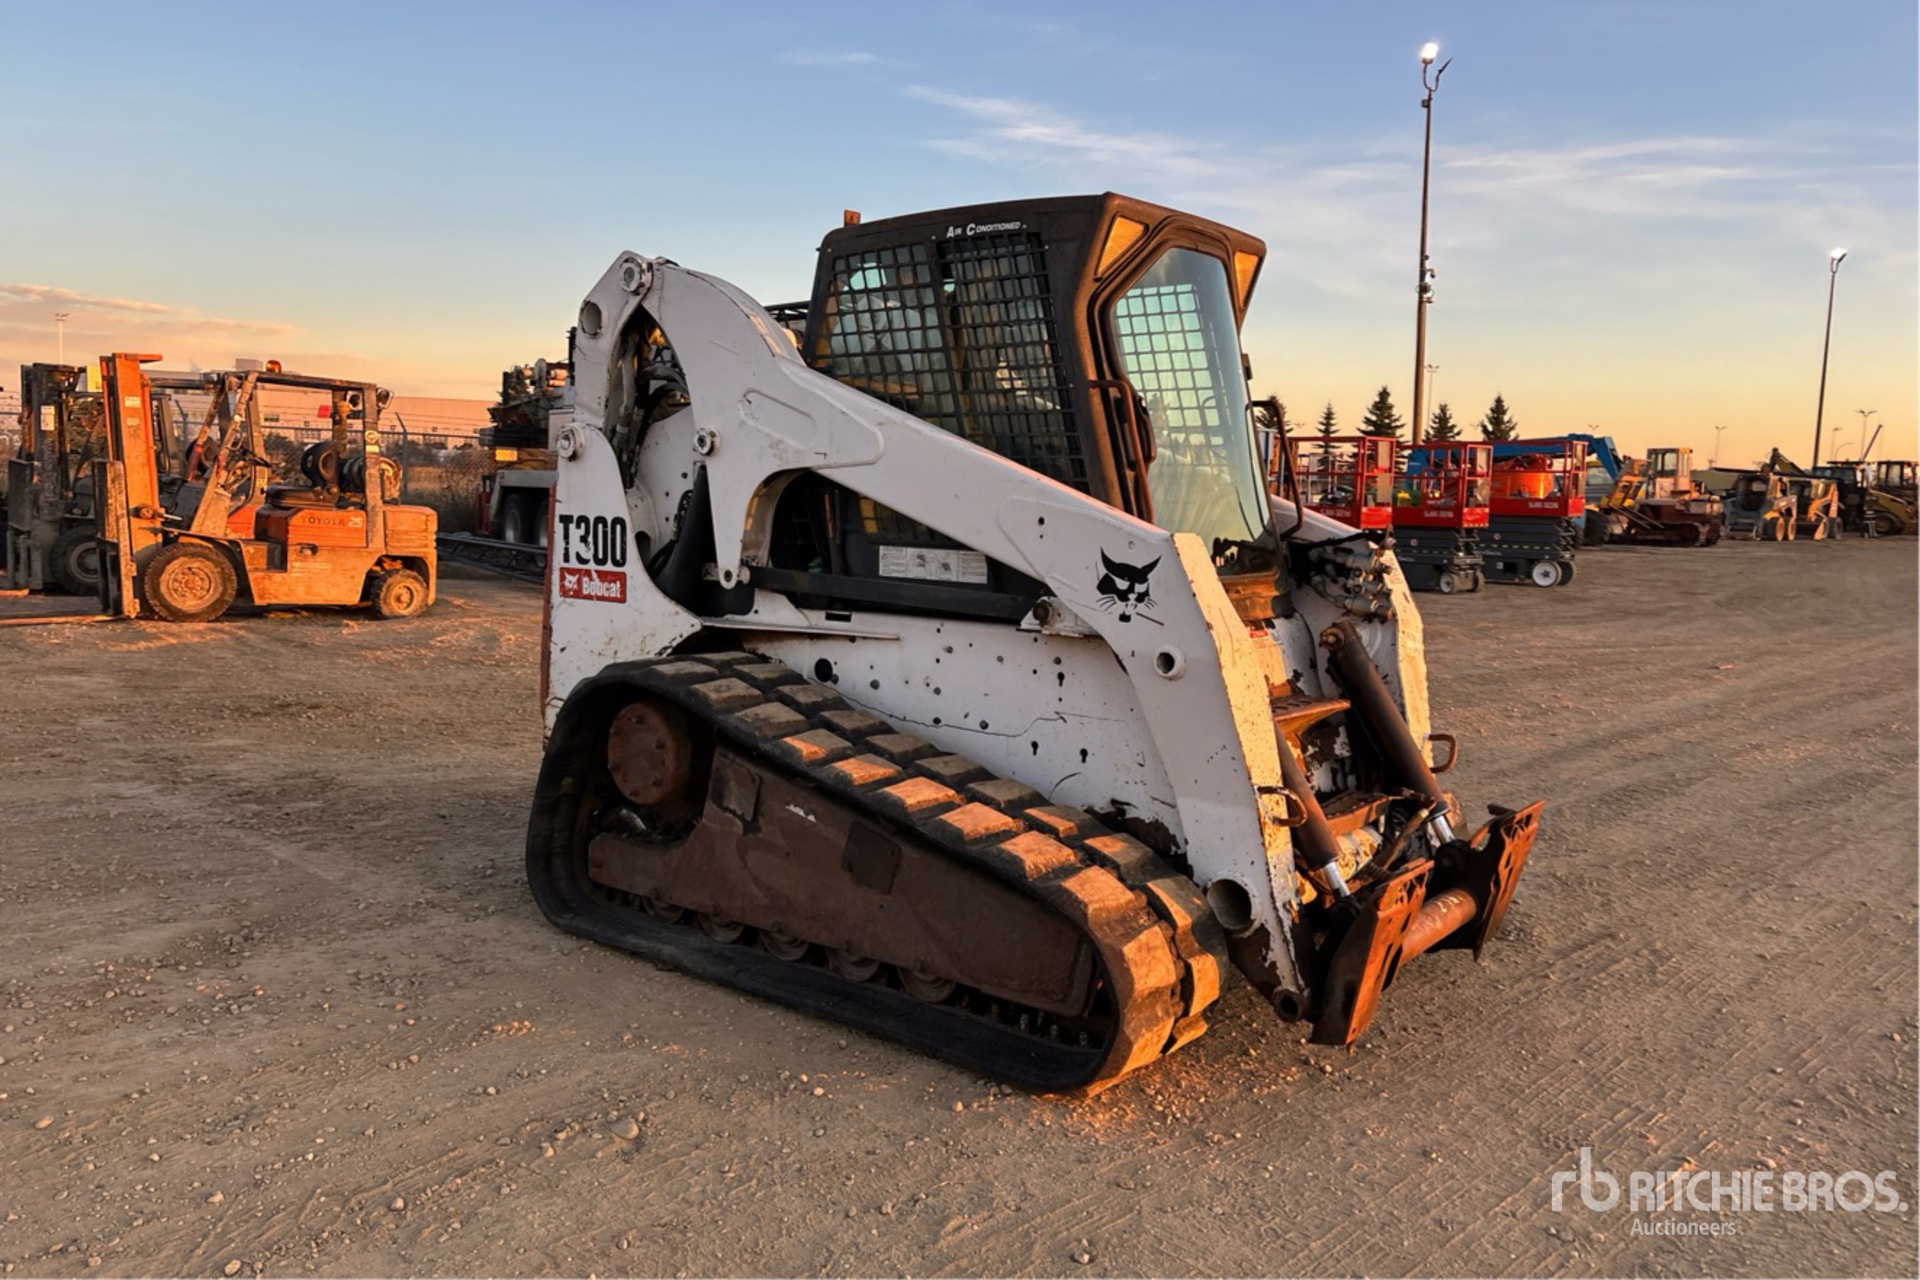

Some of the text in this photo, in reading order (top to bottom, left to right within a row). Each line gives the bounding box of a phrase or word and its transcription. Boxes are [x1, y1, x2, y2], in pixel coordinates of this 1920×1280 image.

[301, 515, 345, 526] TOYOTA
[559, 514, 627, 568] T300
[582, 577, 621, 598] Bobcat
